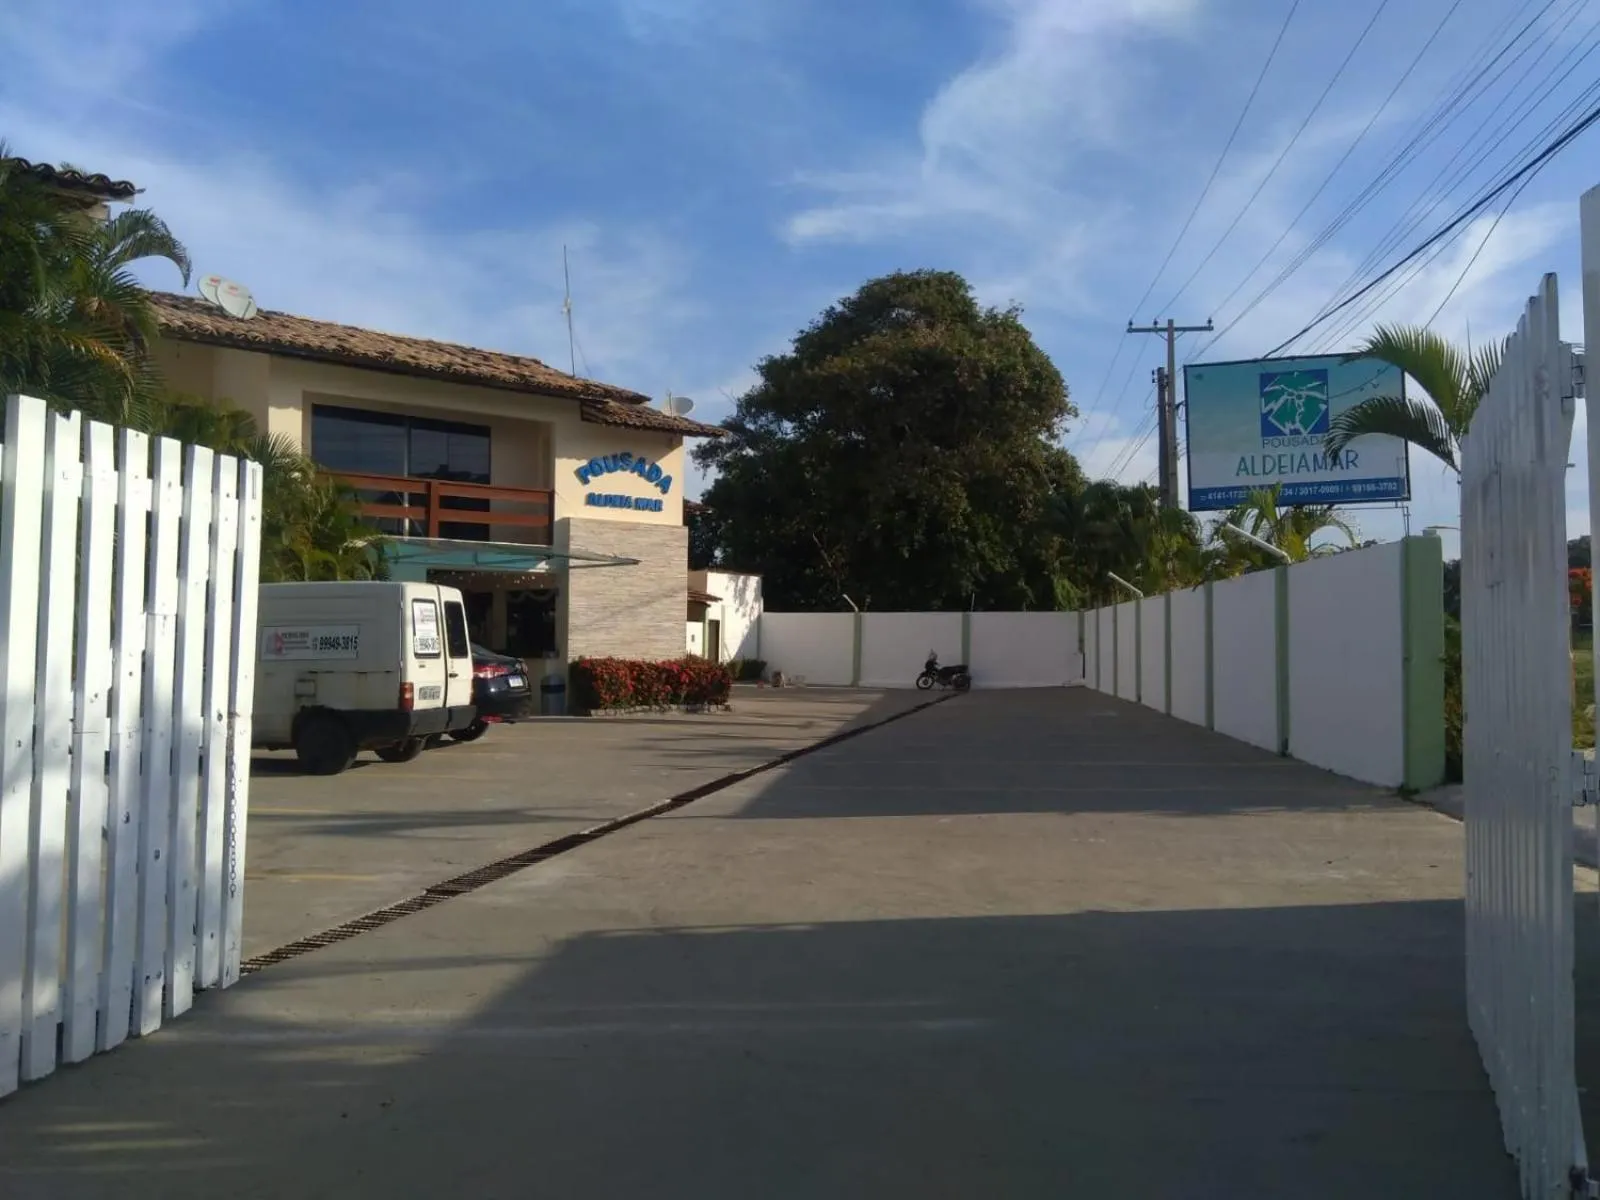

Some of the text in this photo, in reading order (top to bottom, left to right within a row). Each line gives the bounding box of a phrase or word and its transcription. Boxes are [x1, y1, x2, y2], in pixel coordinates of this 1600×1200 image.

[1262, 436, 1326, 449] POUSAD
[573, 451, 673, 495] POUSADA
[1236, 450, 1359, 477] ALDEIAMAR
